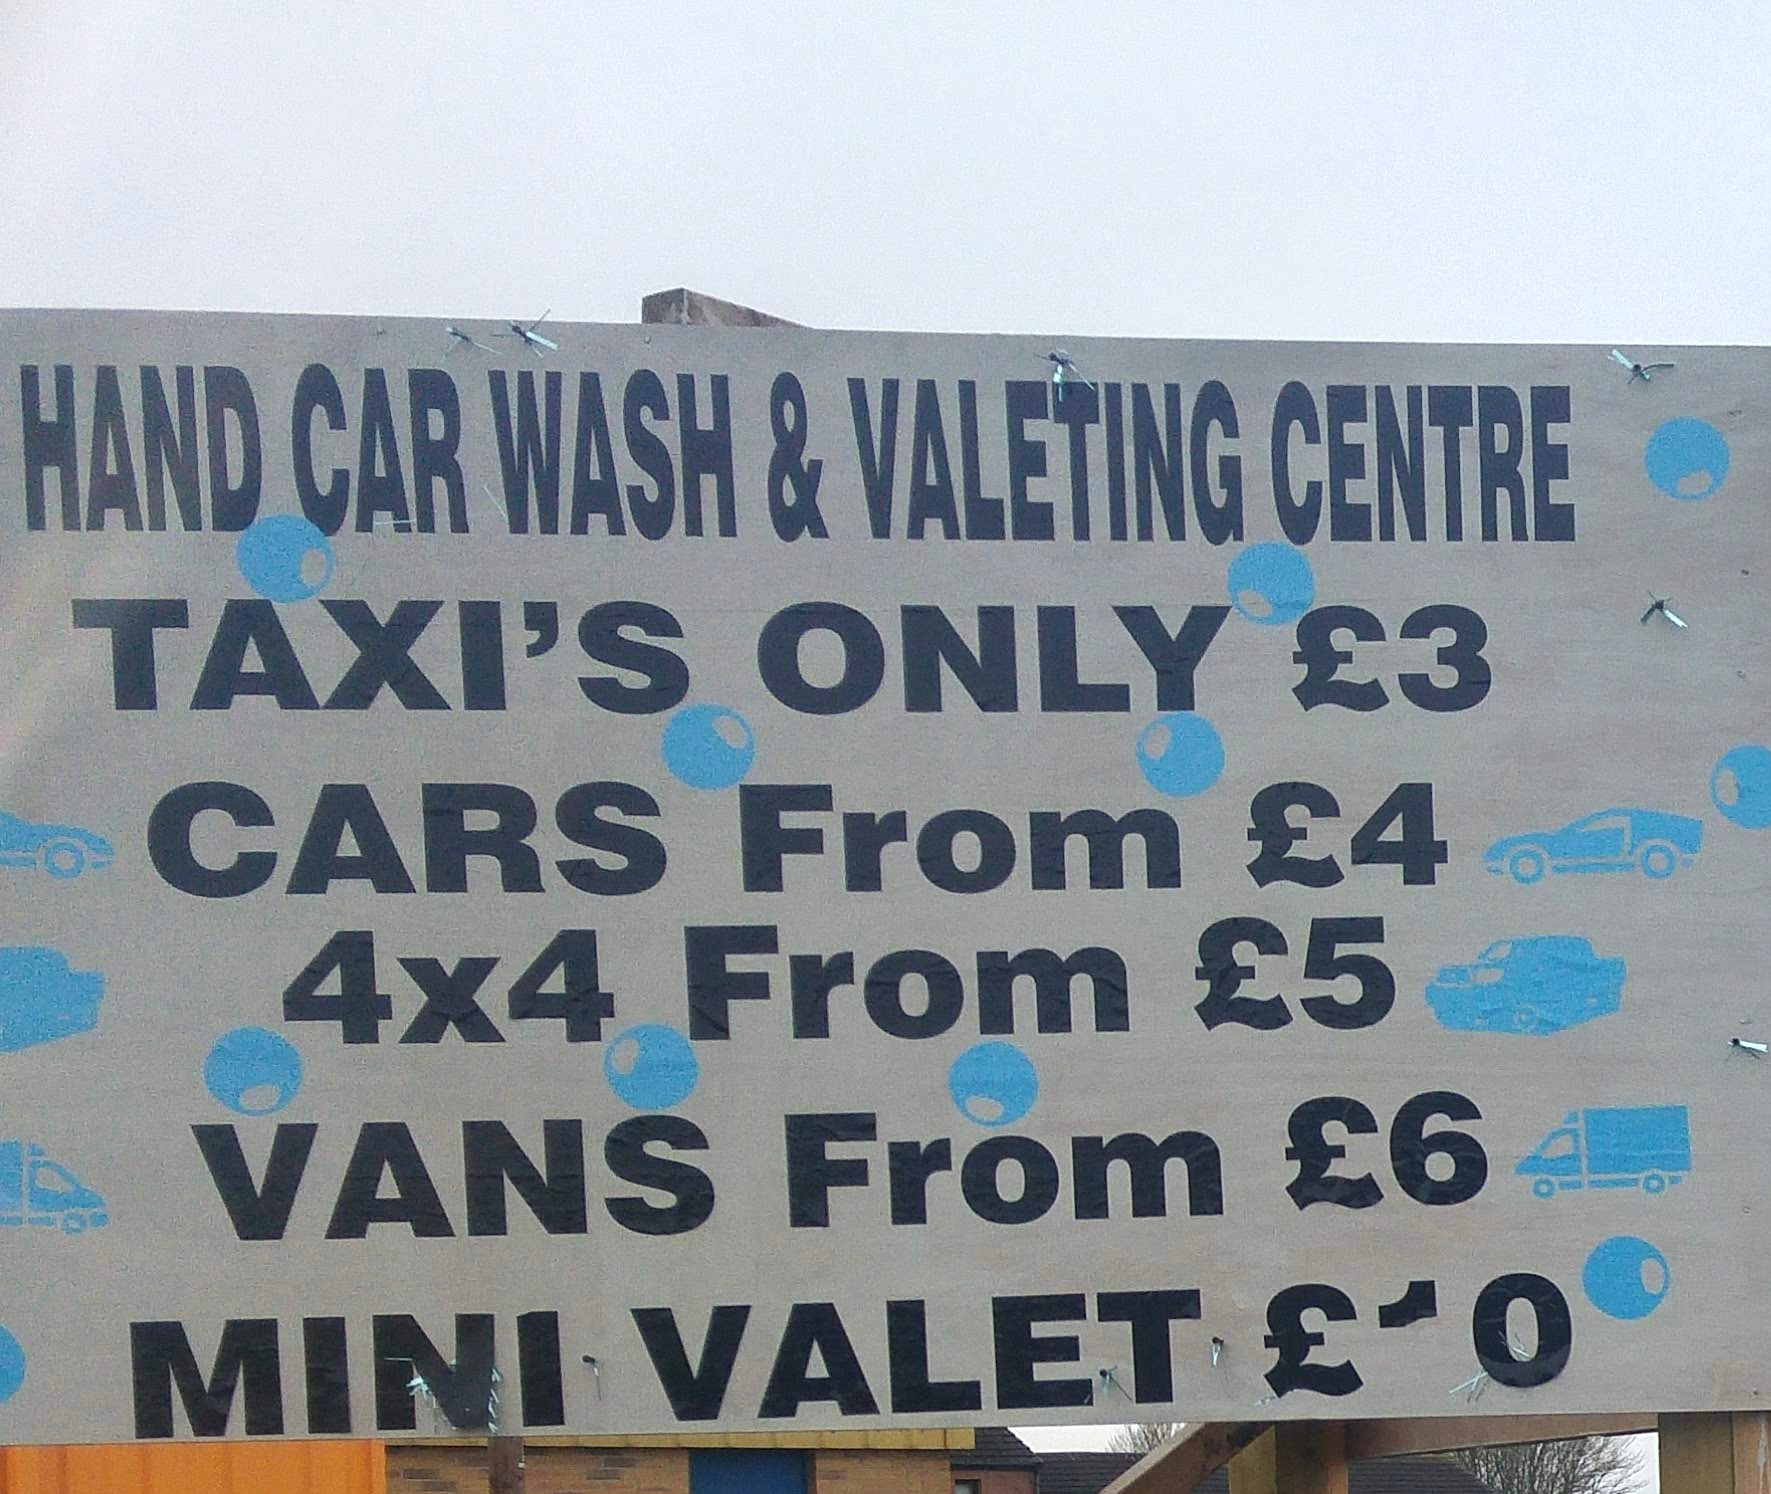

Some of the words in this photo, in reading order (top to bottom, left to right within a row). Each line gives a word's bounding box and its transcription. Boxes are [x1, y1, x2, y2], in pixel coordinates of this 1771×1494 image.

[20, 365, 262, 532] HAND
[291, 363, 470, 537] CAR
[488, 370, 738, 541] WASH
[767, 371, 830, 543] &
[847, 377, 1244, 546] VALETING
[1271, 380, 1576, 546] CENTRE
[72, 598, 690, 715] TAXI'S
[757, 601, 1232, 716] ONLY
[1291, 604, 1492, 713] £3
[147, 781, 668, 899] CARS
[739, 784, 1182, 894] From
[1246, 781, 1448, 889] £4
[282, 929, 616, 1045] 4x4
[684, 924, 1130, 1041] From
[1194, 916, 1396, 1031] £5
[190, 1114, 716, 1242] VANS
[784, 1112, 1224, 1229] From
[1284, 1090, 1488, 1211] £6
[129, 1310, 566, 1441] MINI
[630, 1288, 1202, 1422] VALET
